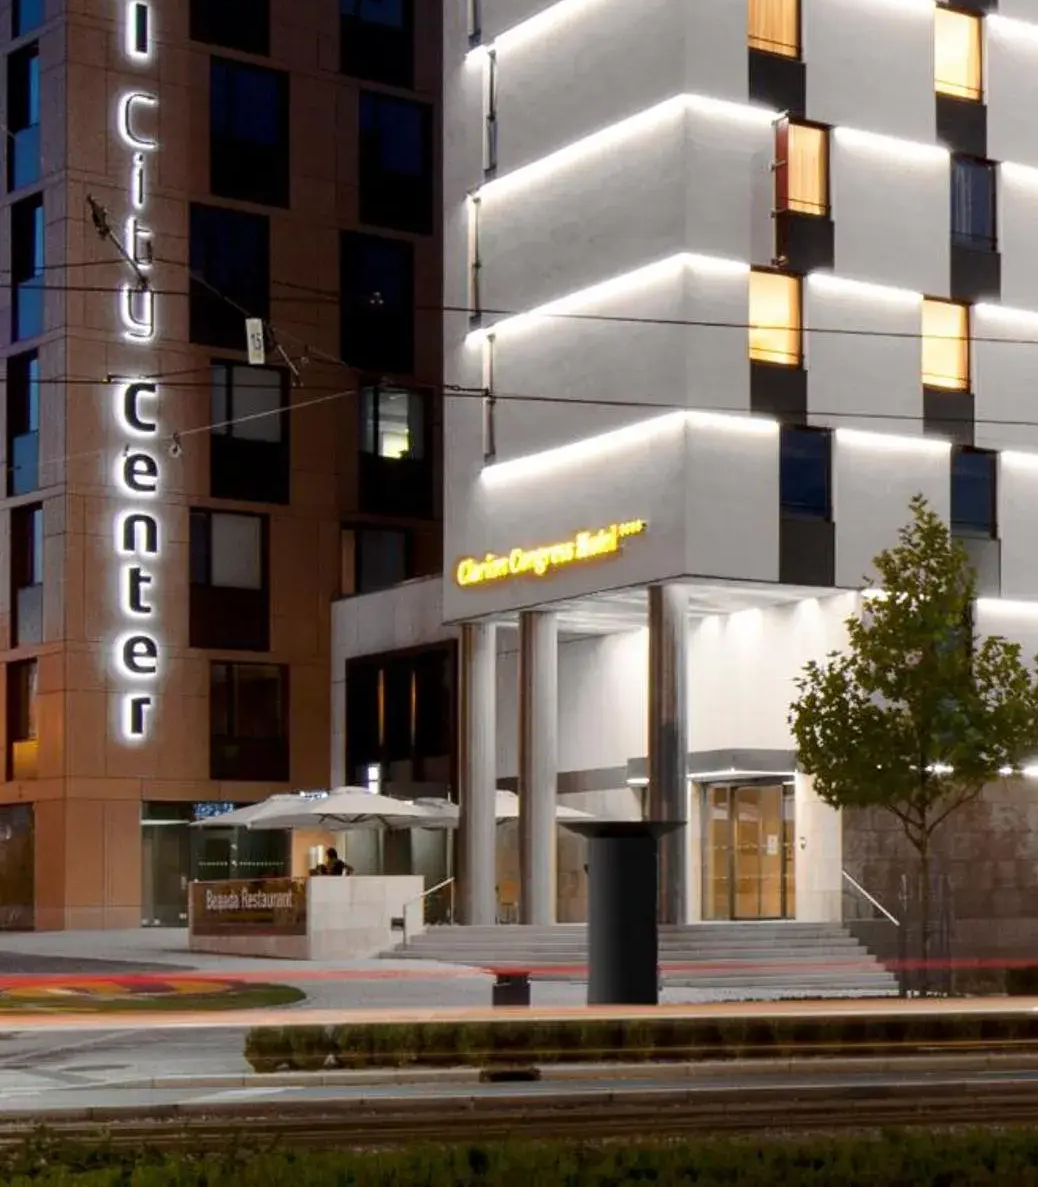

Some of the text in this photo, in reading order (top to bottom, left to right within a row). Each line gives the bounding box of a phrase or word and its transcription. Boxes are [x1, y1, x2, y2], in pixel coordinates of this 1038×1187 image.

[117, 91, 157, 341] City
[117, 378, 158, 740] Center
[241, 887, 292, 908] Restaurant
